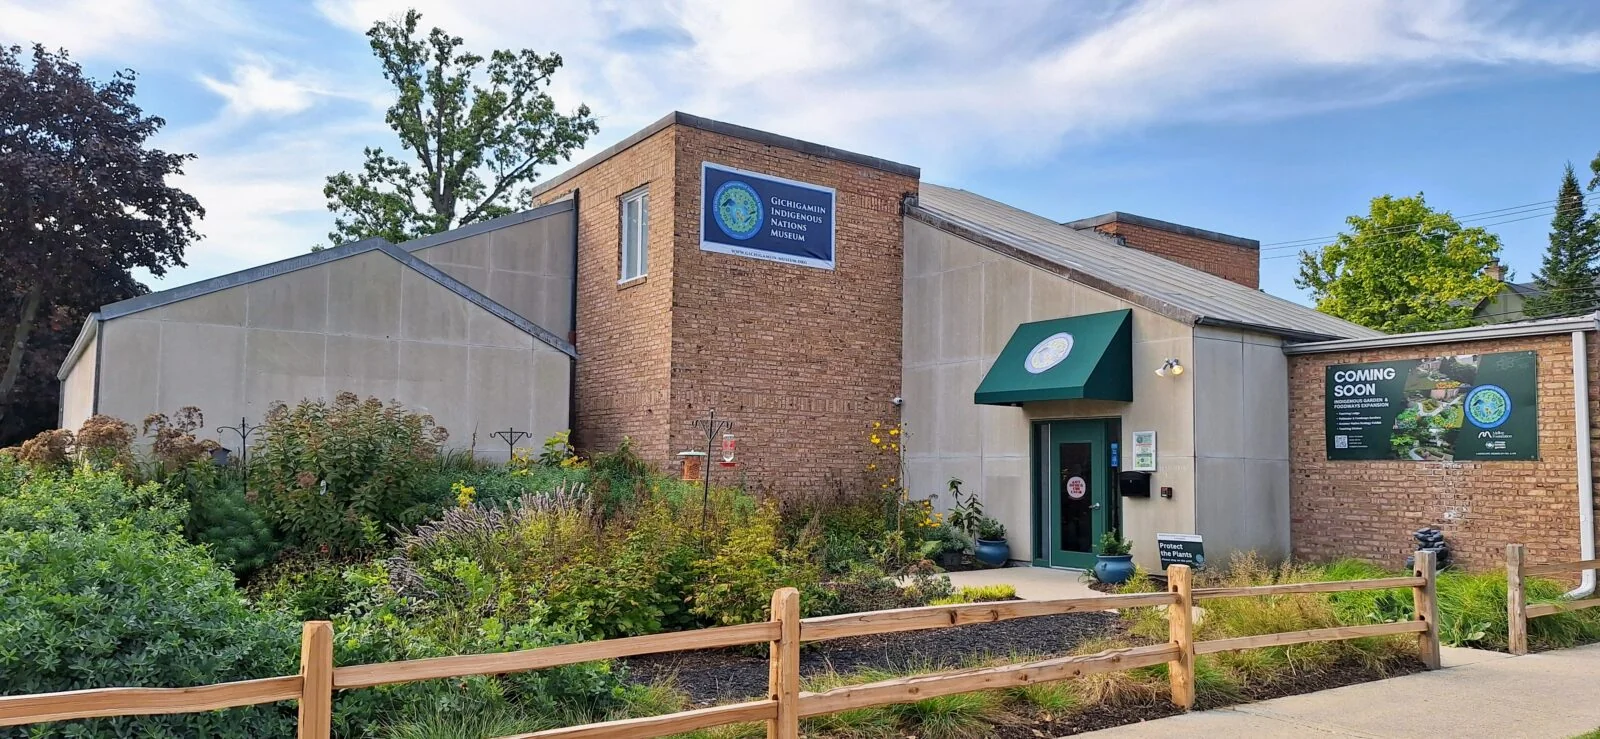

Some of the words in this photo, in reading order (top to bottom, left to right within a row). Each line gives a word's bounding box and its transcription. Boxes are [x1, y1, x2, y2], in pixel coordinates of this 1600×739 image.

[770, 196, 826, 214] GICHIGAMIIN
[771, 207, 823, 224] INDIGENOUS
[770, 218, 807, 231] NATIONS
[770, 228, 805, 242] MUSEUM
[1334, 367, 1396, 383] COMING
[1334, 383, 1376, 397] SOON
[1160, 542, 1183, 550] Protect
